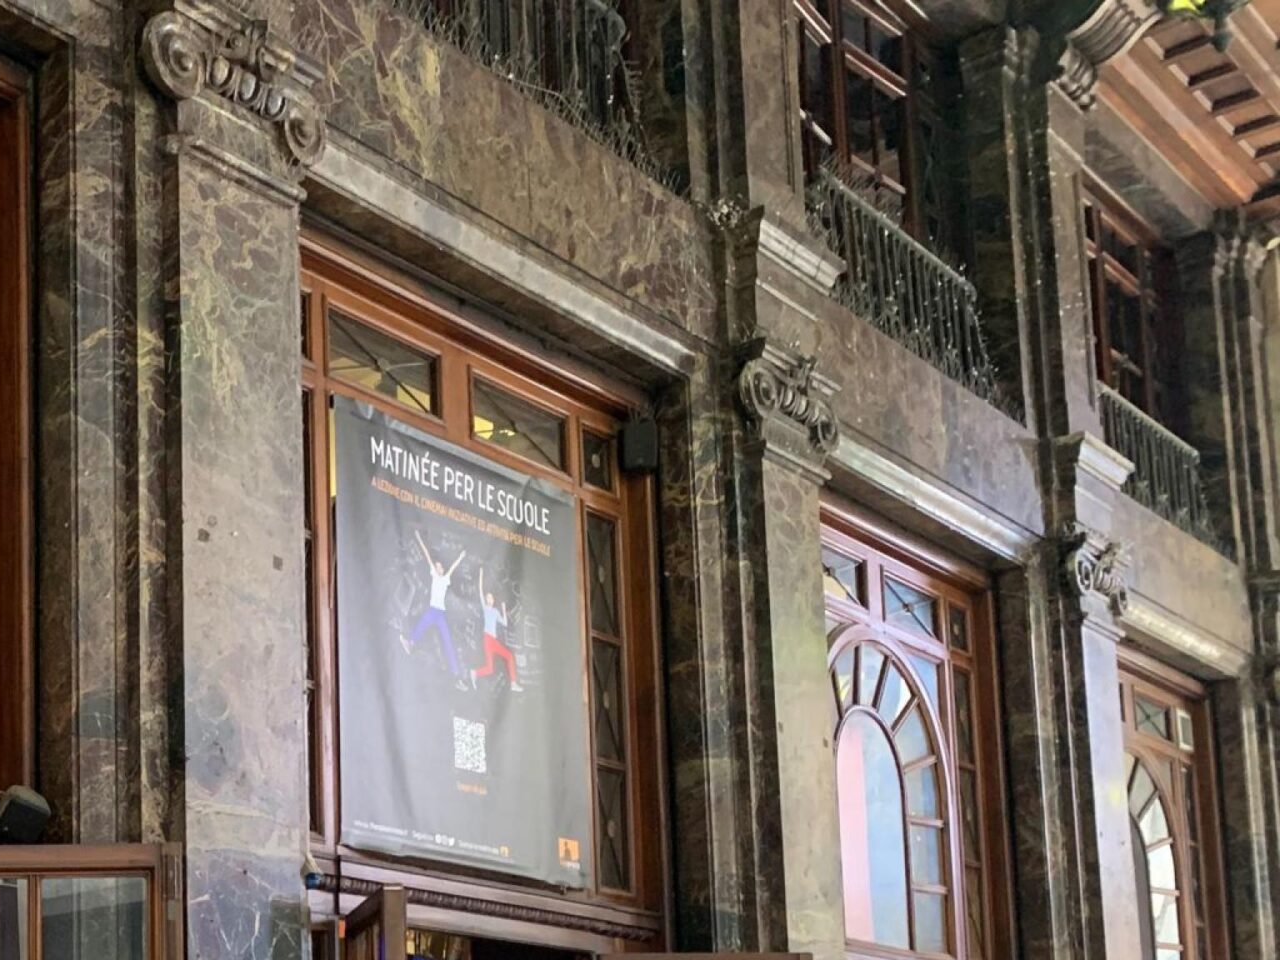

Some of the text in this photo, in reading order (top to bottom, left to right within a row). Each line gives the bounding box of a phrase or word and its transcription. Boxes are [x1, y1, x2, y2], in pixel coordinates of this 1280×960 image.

[370, 436, 551, 535] MATINÉE PER LE SCUOLE
